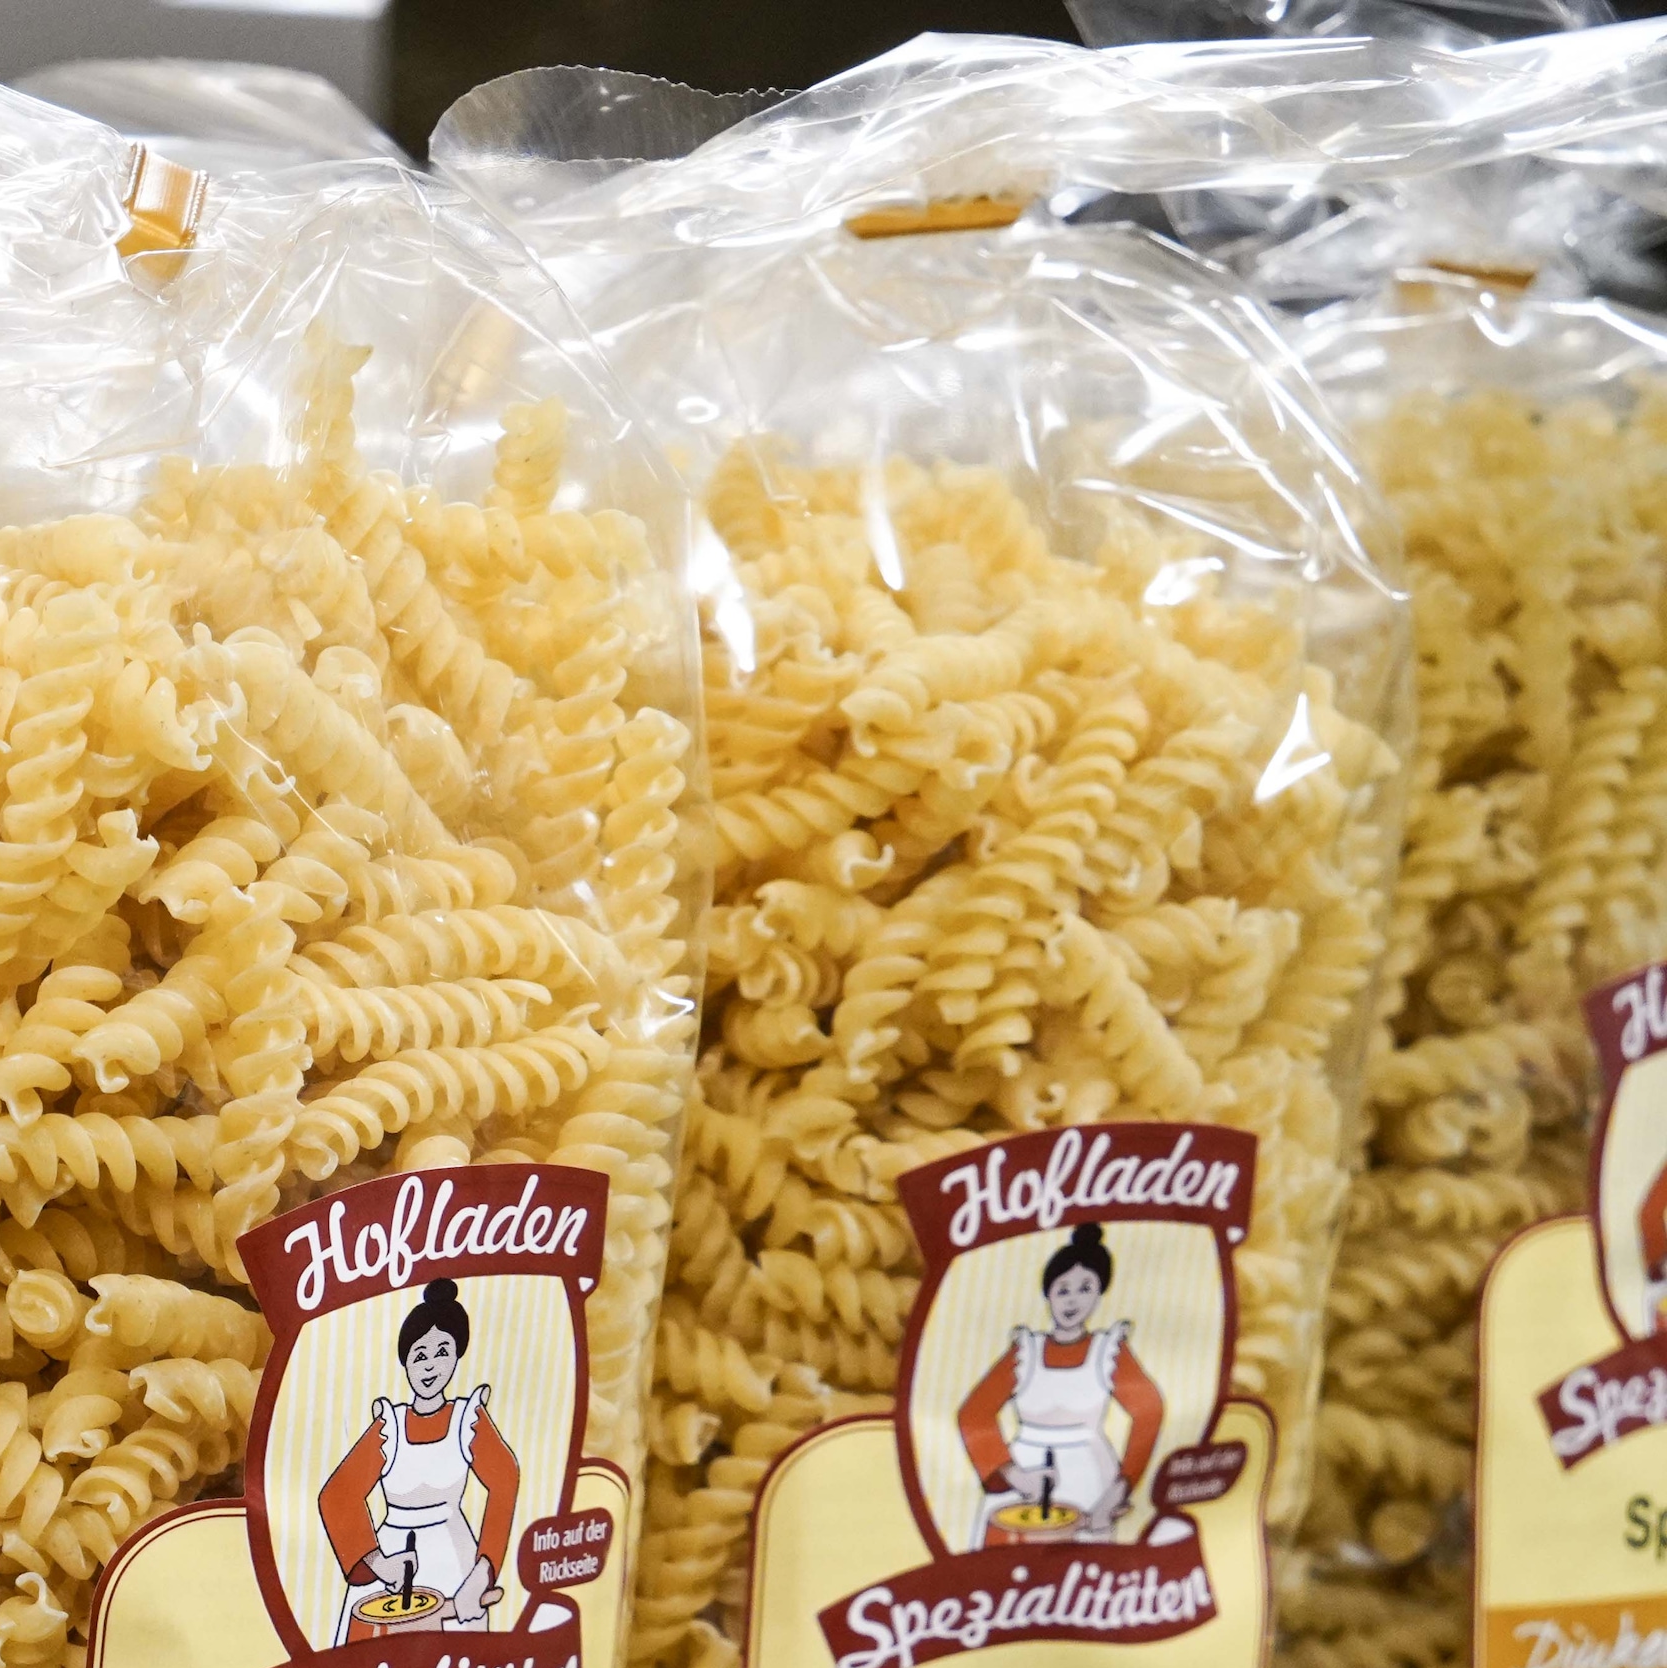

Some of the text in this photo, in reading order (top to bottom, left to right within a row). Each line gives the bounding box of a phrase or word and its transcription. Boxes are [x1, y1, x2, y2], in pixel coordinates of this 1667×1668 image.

[940, 1127, 1239, 1246] Hofladen
[284, 1174, 588, 1311] Hofladen
[533, 1519, 607, 1552] Info auf der
[539, 1553, 598, 1583] Rückseite
